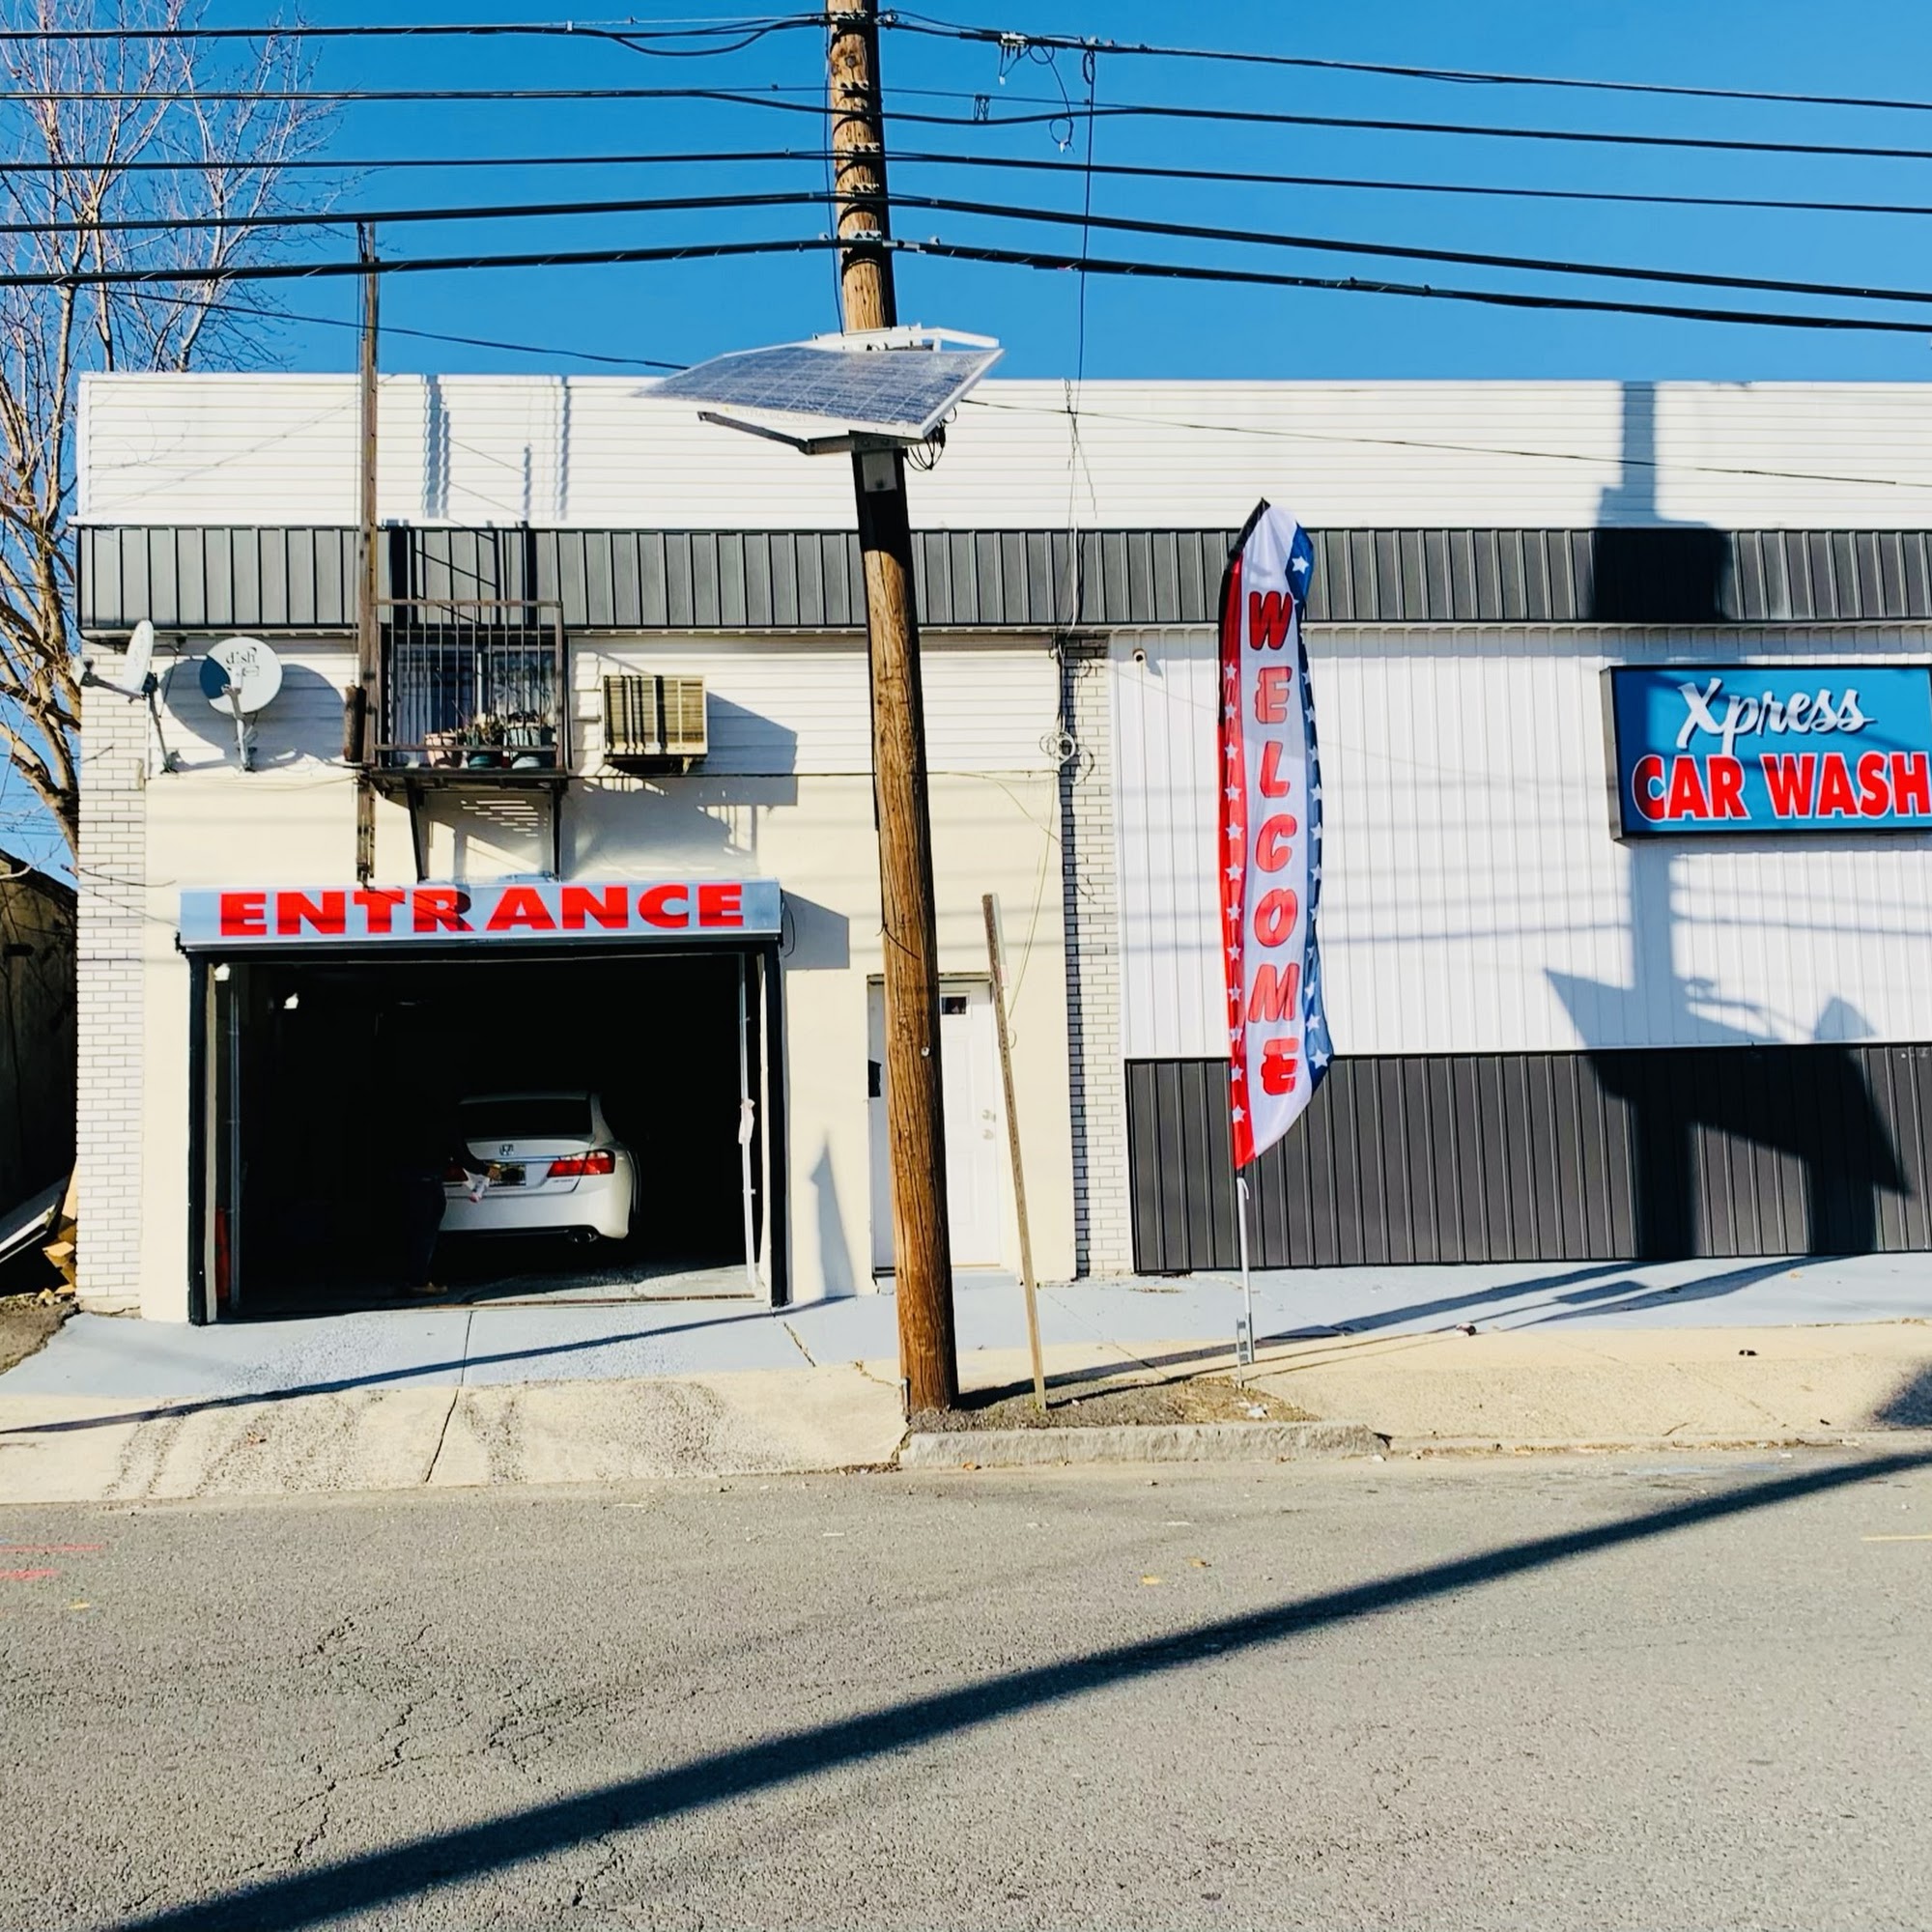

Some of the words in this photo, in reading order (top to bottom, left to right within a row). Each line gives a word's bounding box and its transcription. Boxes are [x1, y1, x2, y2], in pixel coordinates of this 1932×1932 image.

[1676, 677, 1877, 755] Xpress
[1633, 753, 1751, 822] CAR
[1759, 751, 1932, 819] WASH
[1247, 590, 1300, 1095] WELCOME
[220, 884, 745, 937] ENTRANCE
